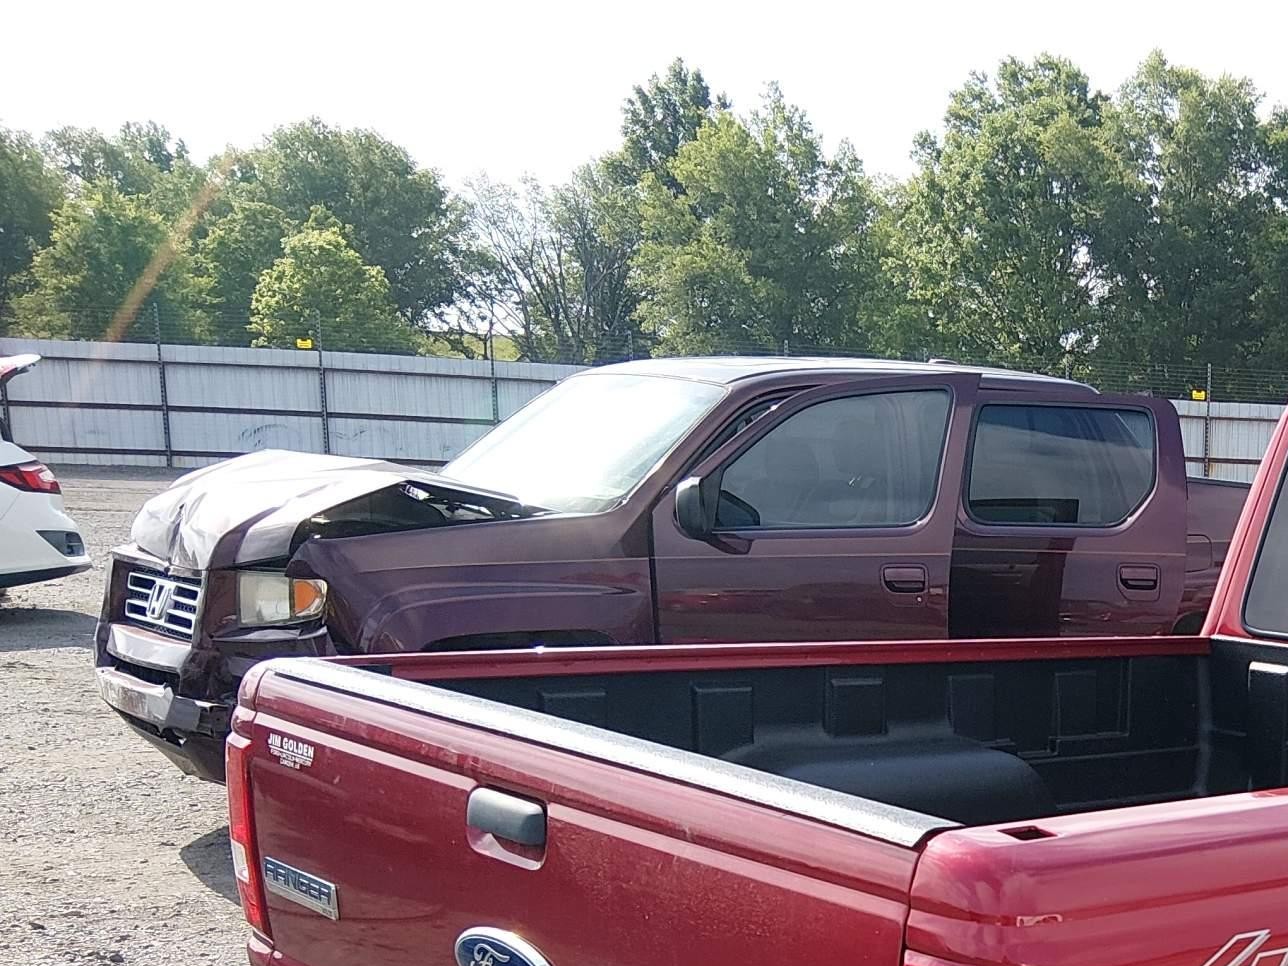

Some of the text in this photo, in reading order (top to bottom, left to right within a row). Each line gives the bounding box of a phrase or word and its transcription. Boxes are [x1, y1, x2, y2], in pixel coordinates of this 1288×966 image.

[267, 732, 315, 759] JIM GOLDEN
[264, 862, 332, 906] RANGER
